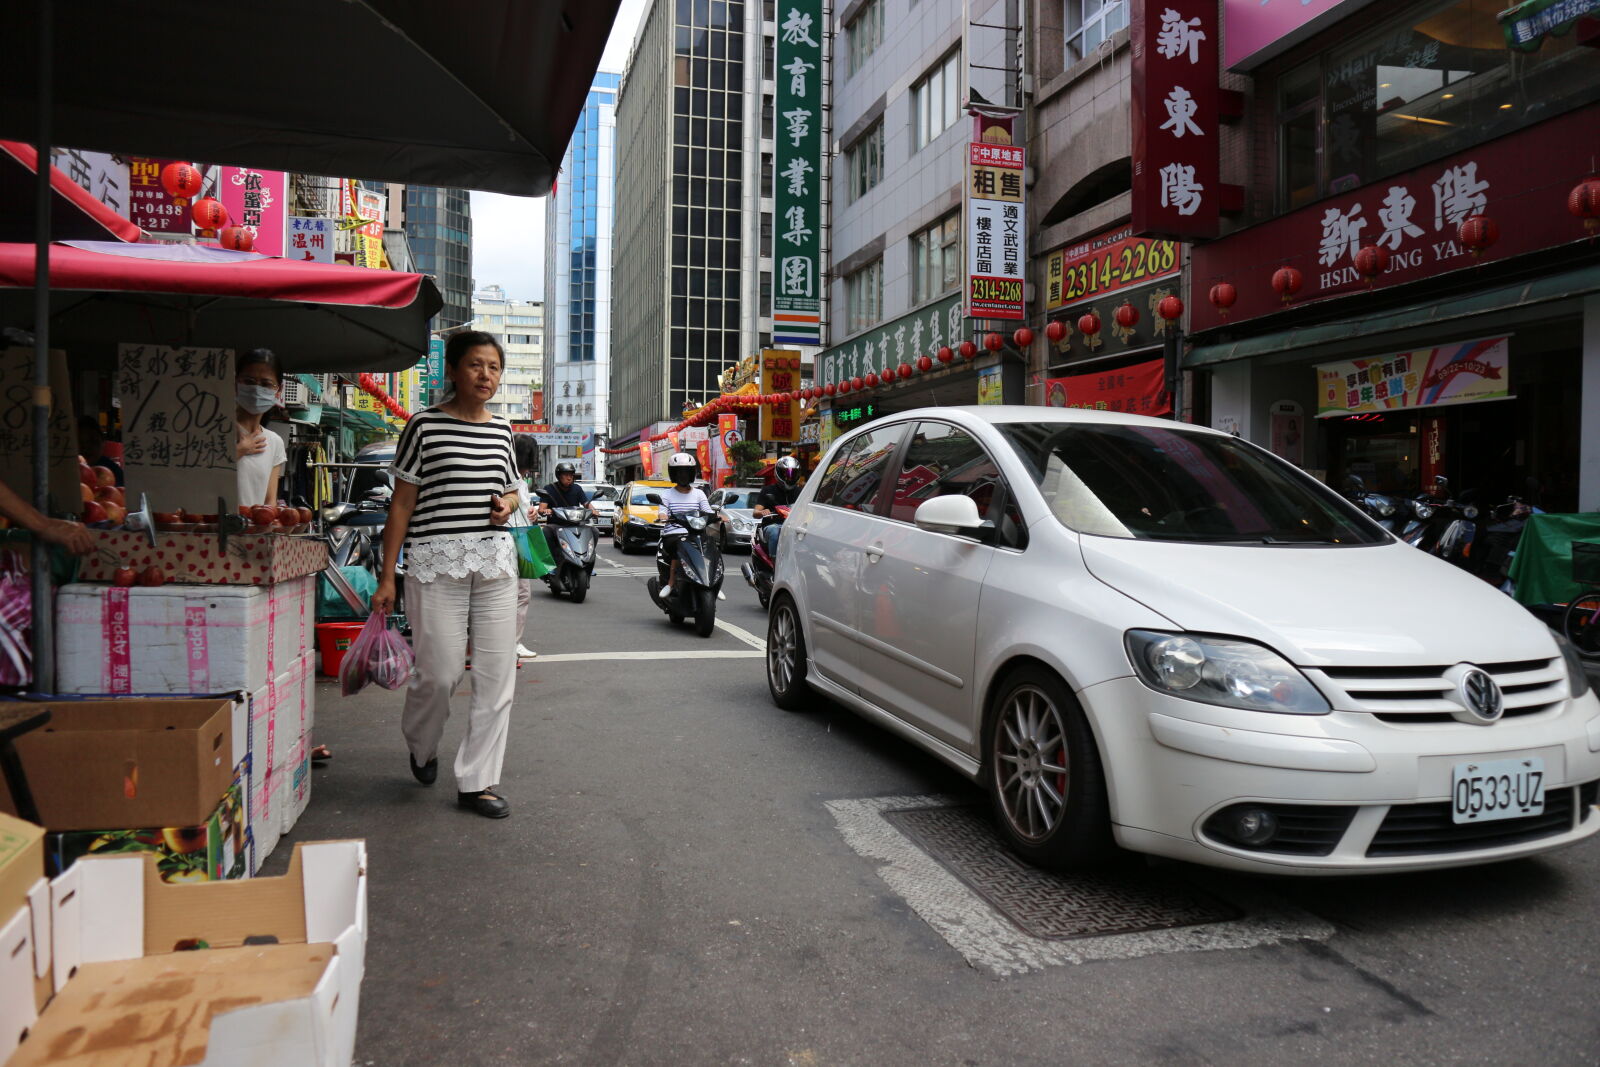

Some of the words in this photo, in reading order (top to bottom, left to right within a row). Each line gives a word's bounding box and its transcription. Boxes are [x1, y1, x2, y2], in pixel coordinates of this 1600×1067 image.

[1156, 7, 1206, 216] 新東陽
[132, 159, 159, 186] 型
[781, 8, 819, 297] 教育事業集團
[980, 147, 1023, 162] 中原地產
[974, 169, 1020, 198] 租售
[1318, 161, 1490, 267] 新東陽
[976, 205, 992, 274] 一樓金店面
[1003, 204, 1019, 276] 適文武百業
[972, 278, 1022, 302] 2314-2268
[1050, 256, 1064, 302] 租售
[1065, 239, 1175, 300] 2314-2268
[972, 301, 1022, 310] tw.centanet.com
[112, 611, 125, 655] Apple
